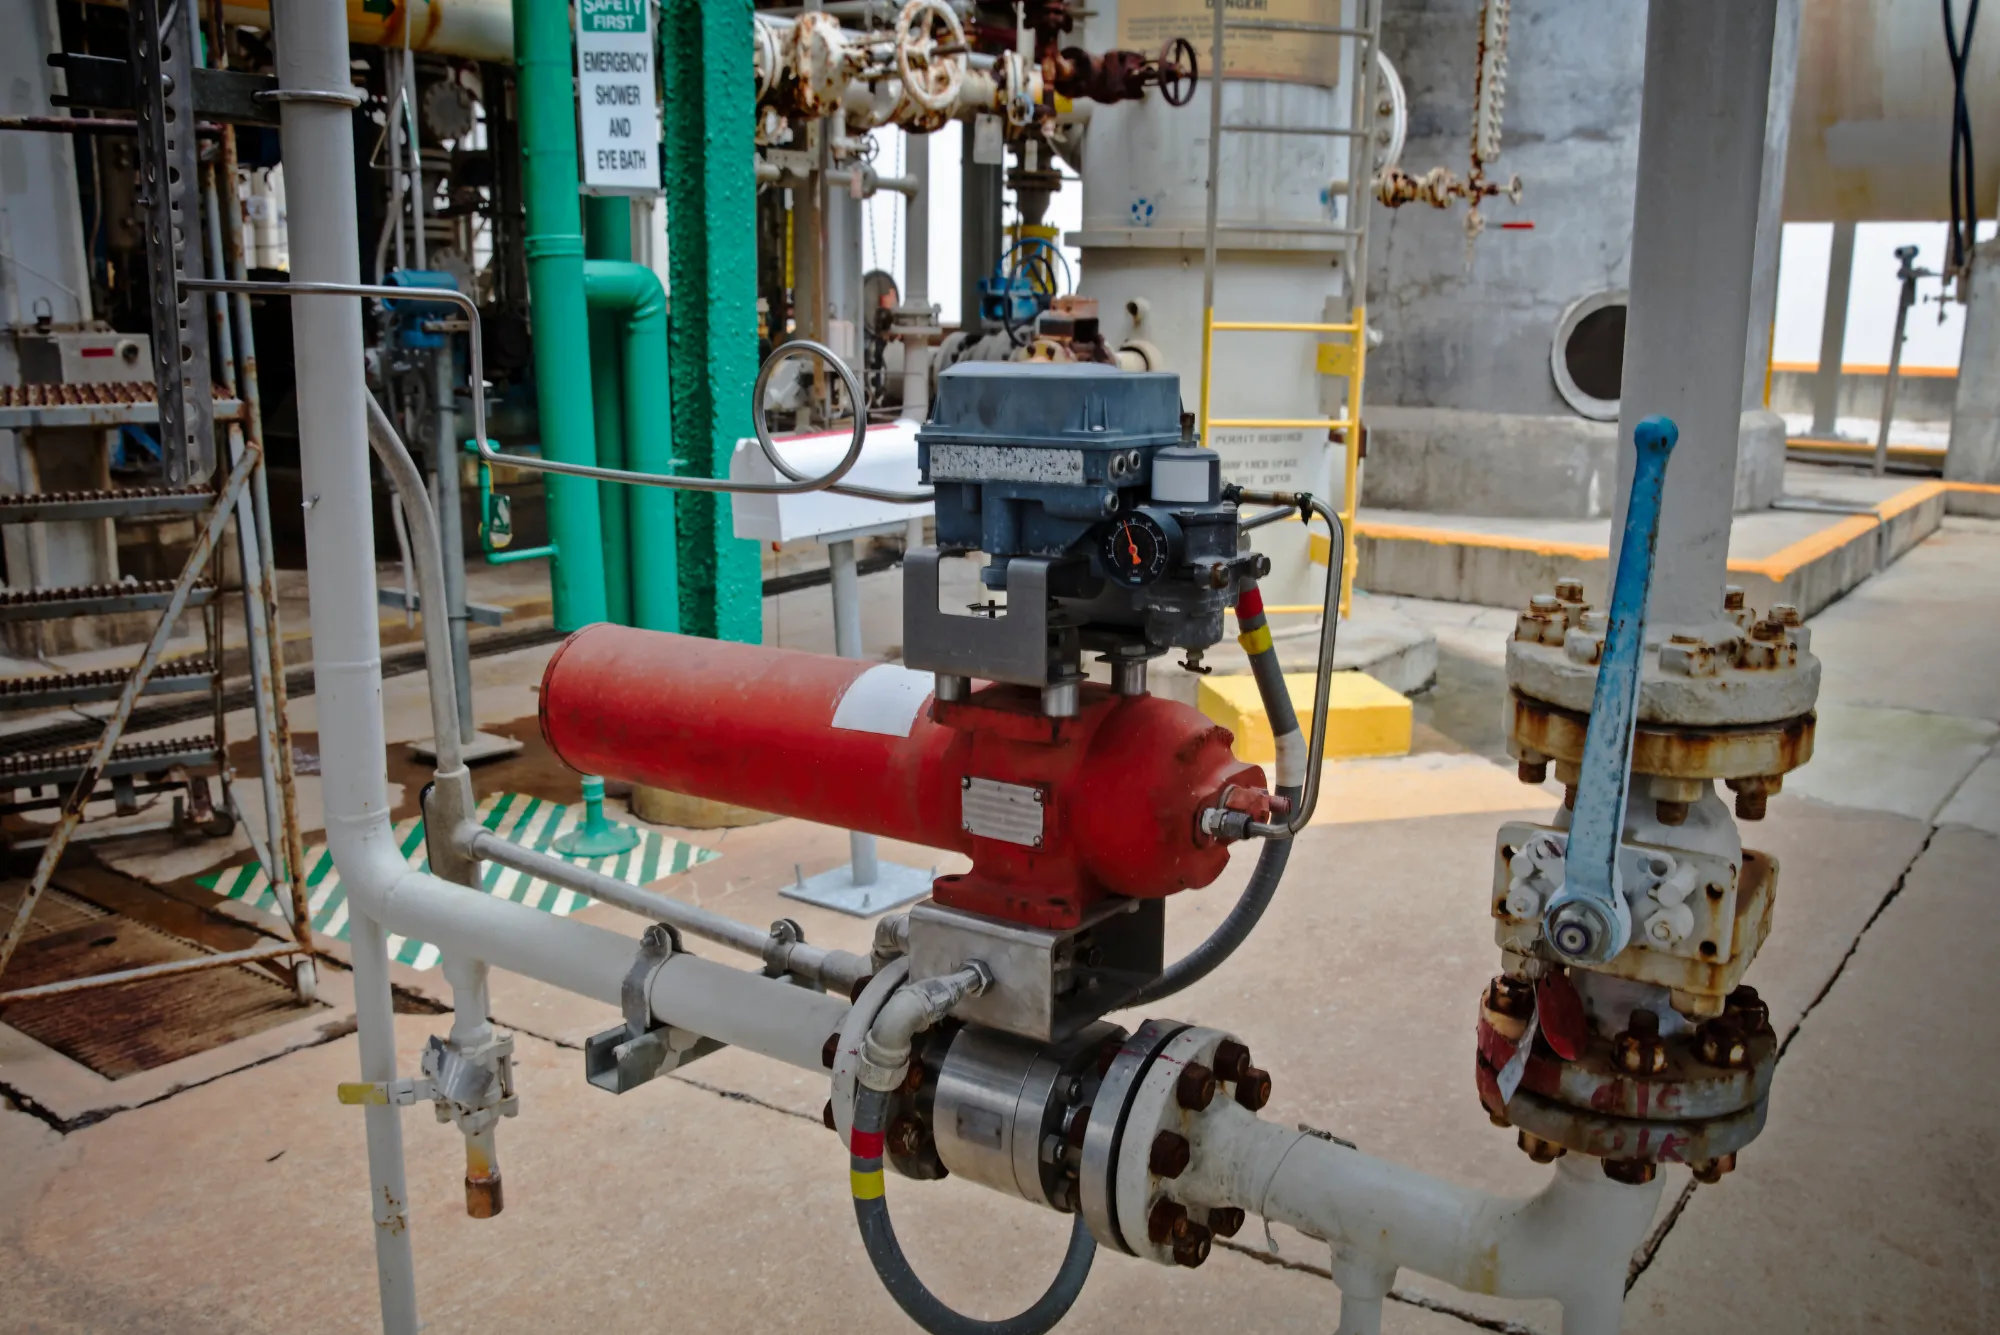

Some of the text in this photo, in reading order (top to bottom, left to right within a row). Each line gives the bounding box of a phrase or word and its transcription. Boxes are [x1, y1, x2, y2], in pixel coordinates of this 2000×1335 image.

[583, 0, 641, 15] SAFETY
[1205, 0, 1267, 11] DNGER!
[593, 14, 634, 30] FIRST
[584, 52, 648, 72] EMERGENCY
[595, 85, 640, 106] SHOWER
[609, 117, 631, 137] AND
[597, 150, 646, 169] EYE BATH
